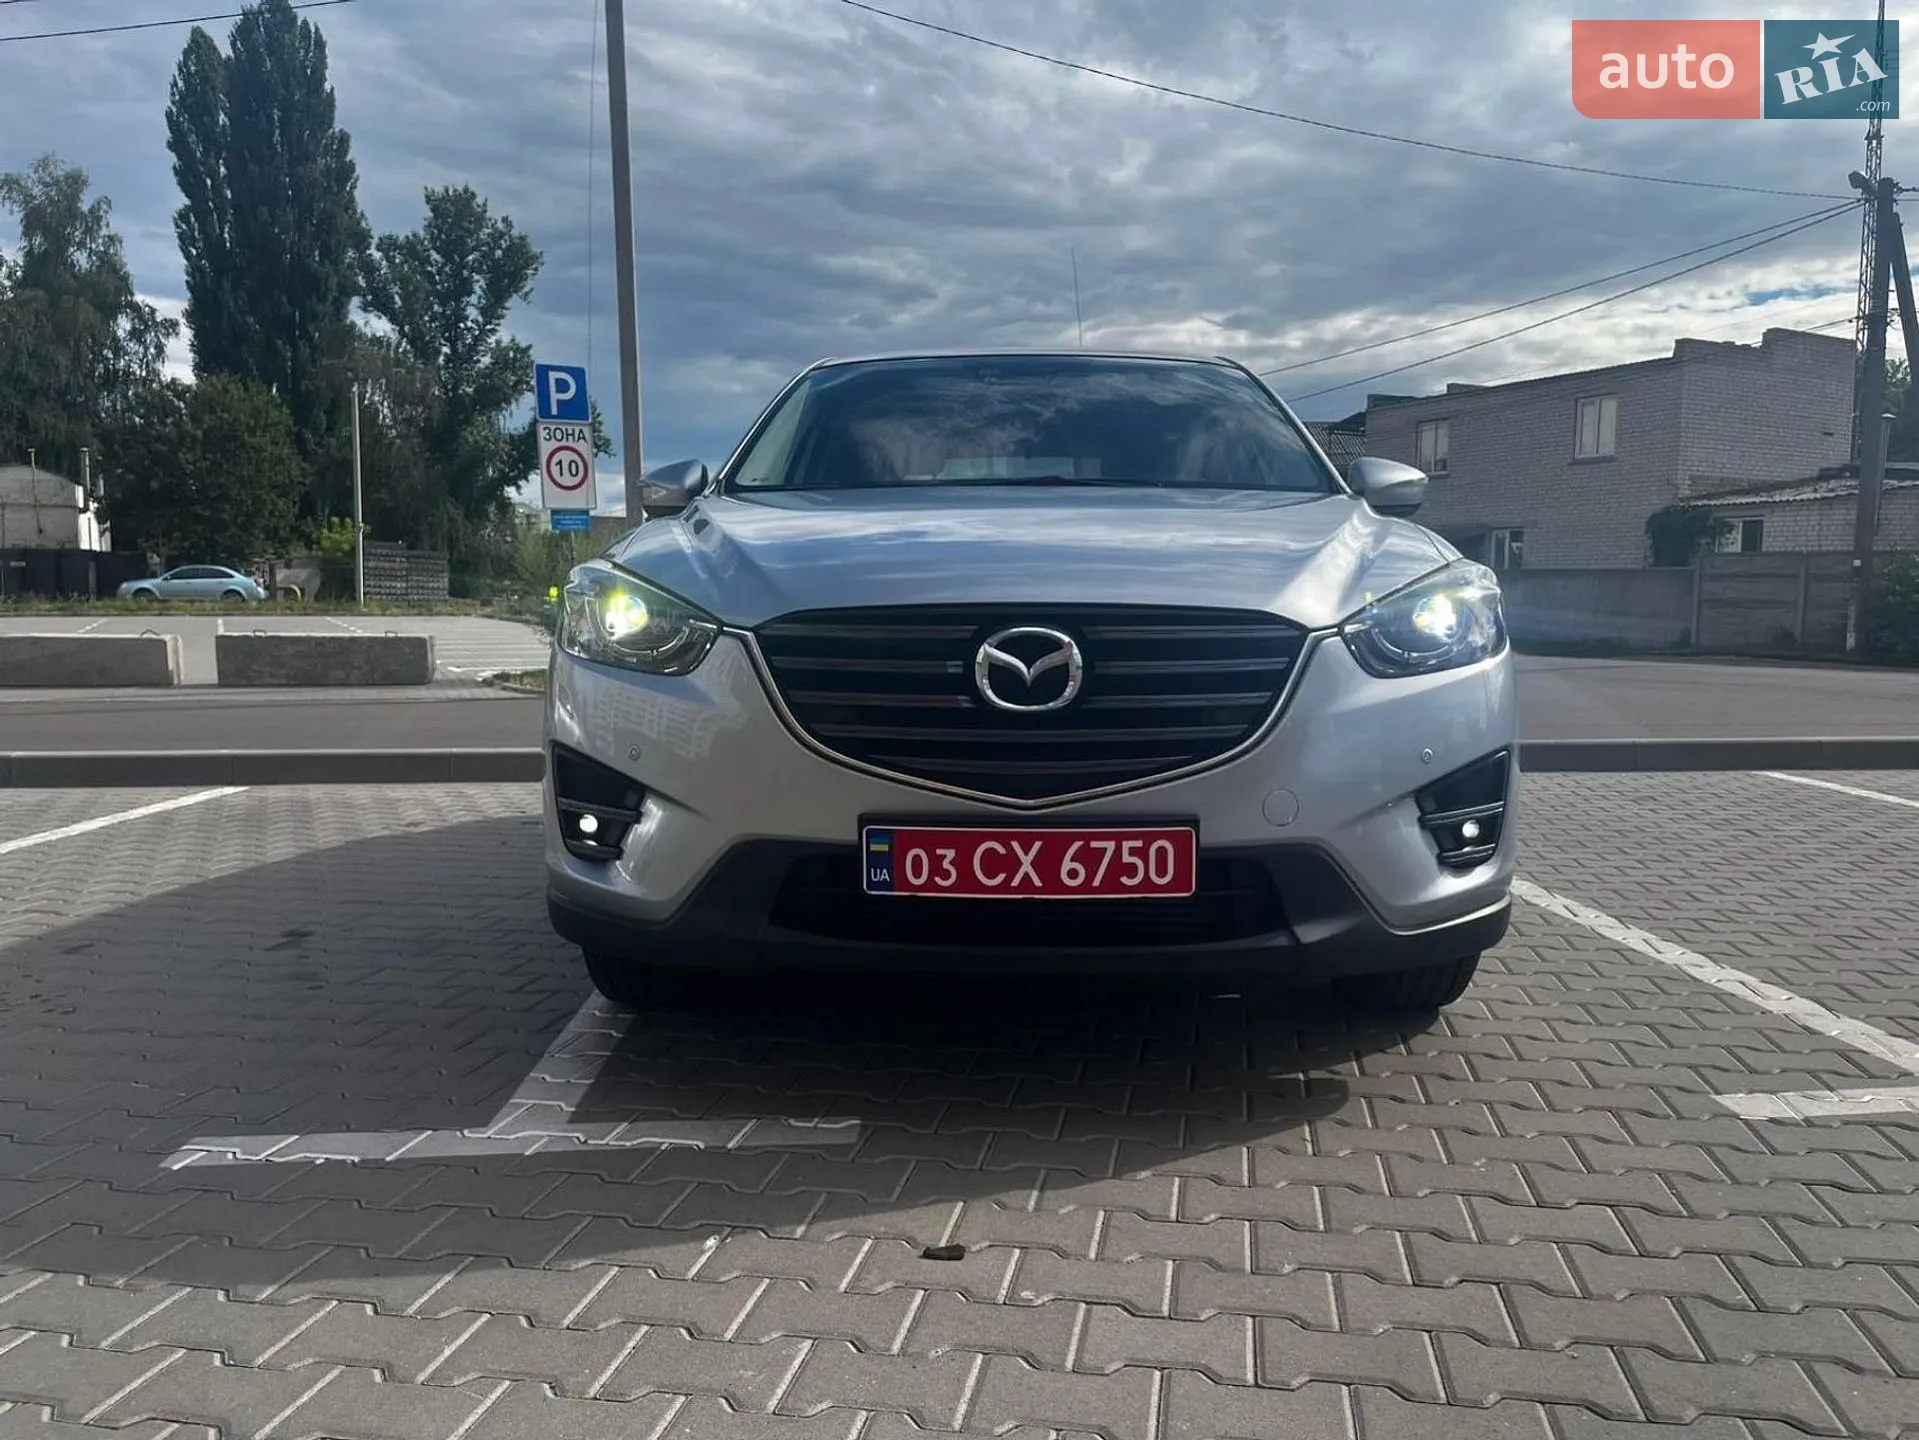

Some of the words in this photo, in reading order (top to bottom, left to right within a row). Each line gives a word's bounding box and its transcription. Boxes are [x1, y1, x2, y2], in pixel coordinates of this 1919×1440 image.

[548, 371, 577, 416] P
[542, 426, 588, 443] ЗОНА
[555, 459, 579, 478] 10
[905, 848, 957, 886] 03
[973, 841, 1043, 887] CX
[1060, 839, 1175, 887] 6750
[870, 868, 890, 882] UA
